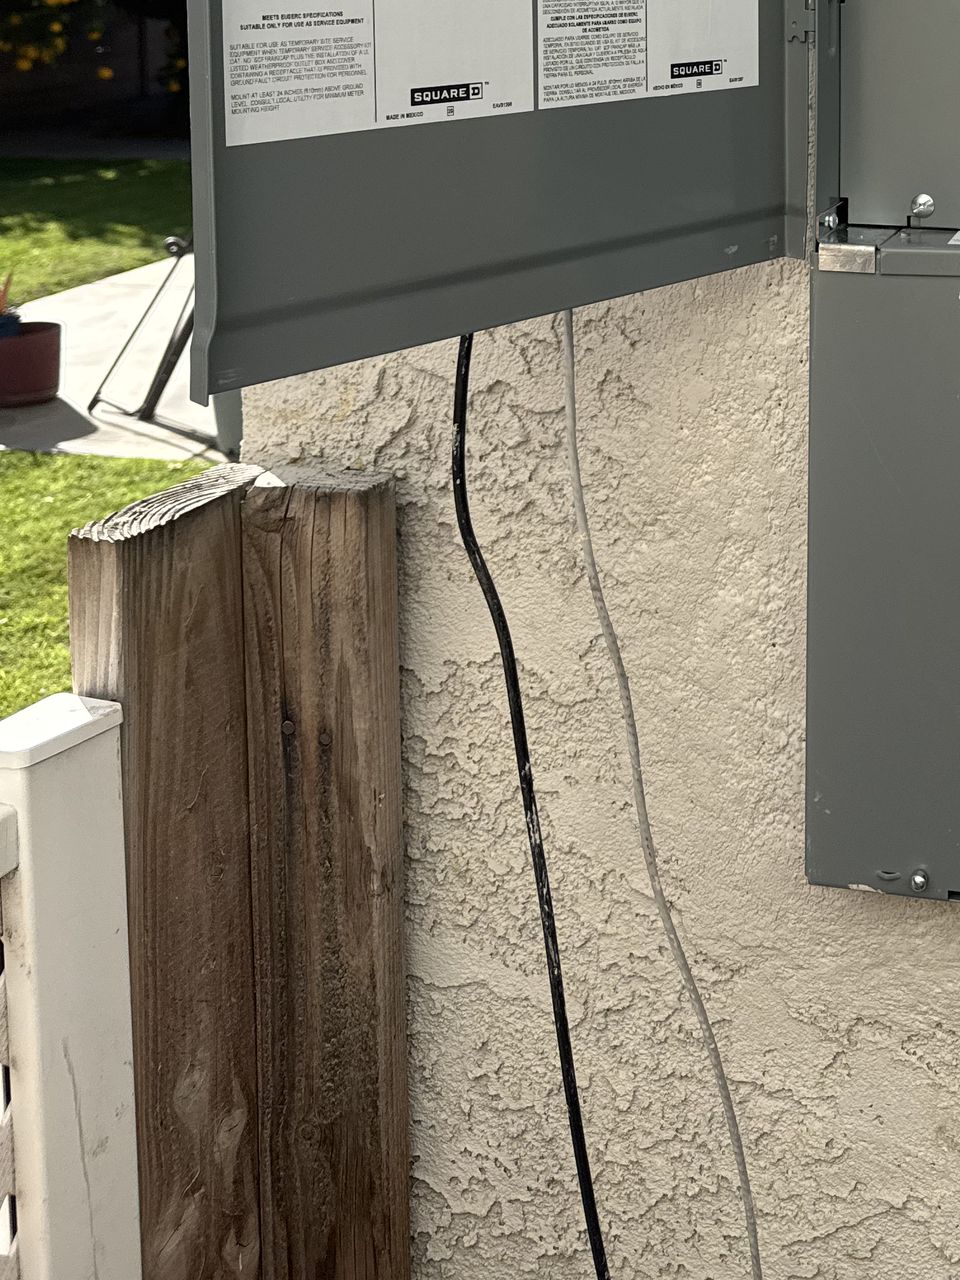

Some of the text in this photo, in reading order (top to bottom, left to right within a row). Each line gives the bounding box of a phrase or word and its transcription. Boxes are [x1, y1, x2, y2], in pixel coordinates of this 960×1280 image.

[673, 63, 721, 75] SQUARE D
[414, 86, 480, 102] SQUARE D
